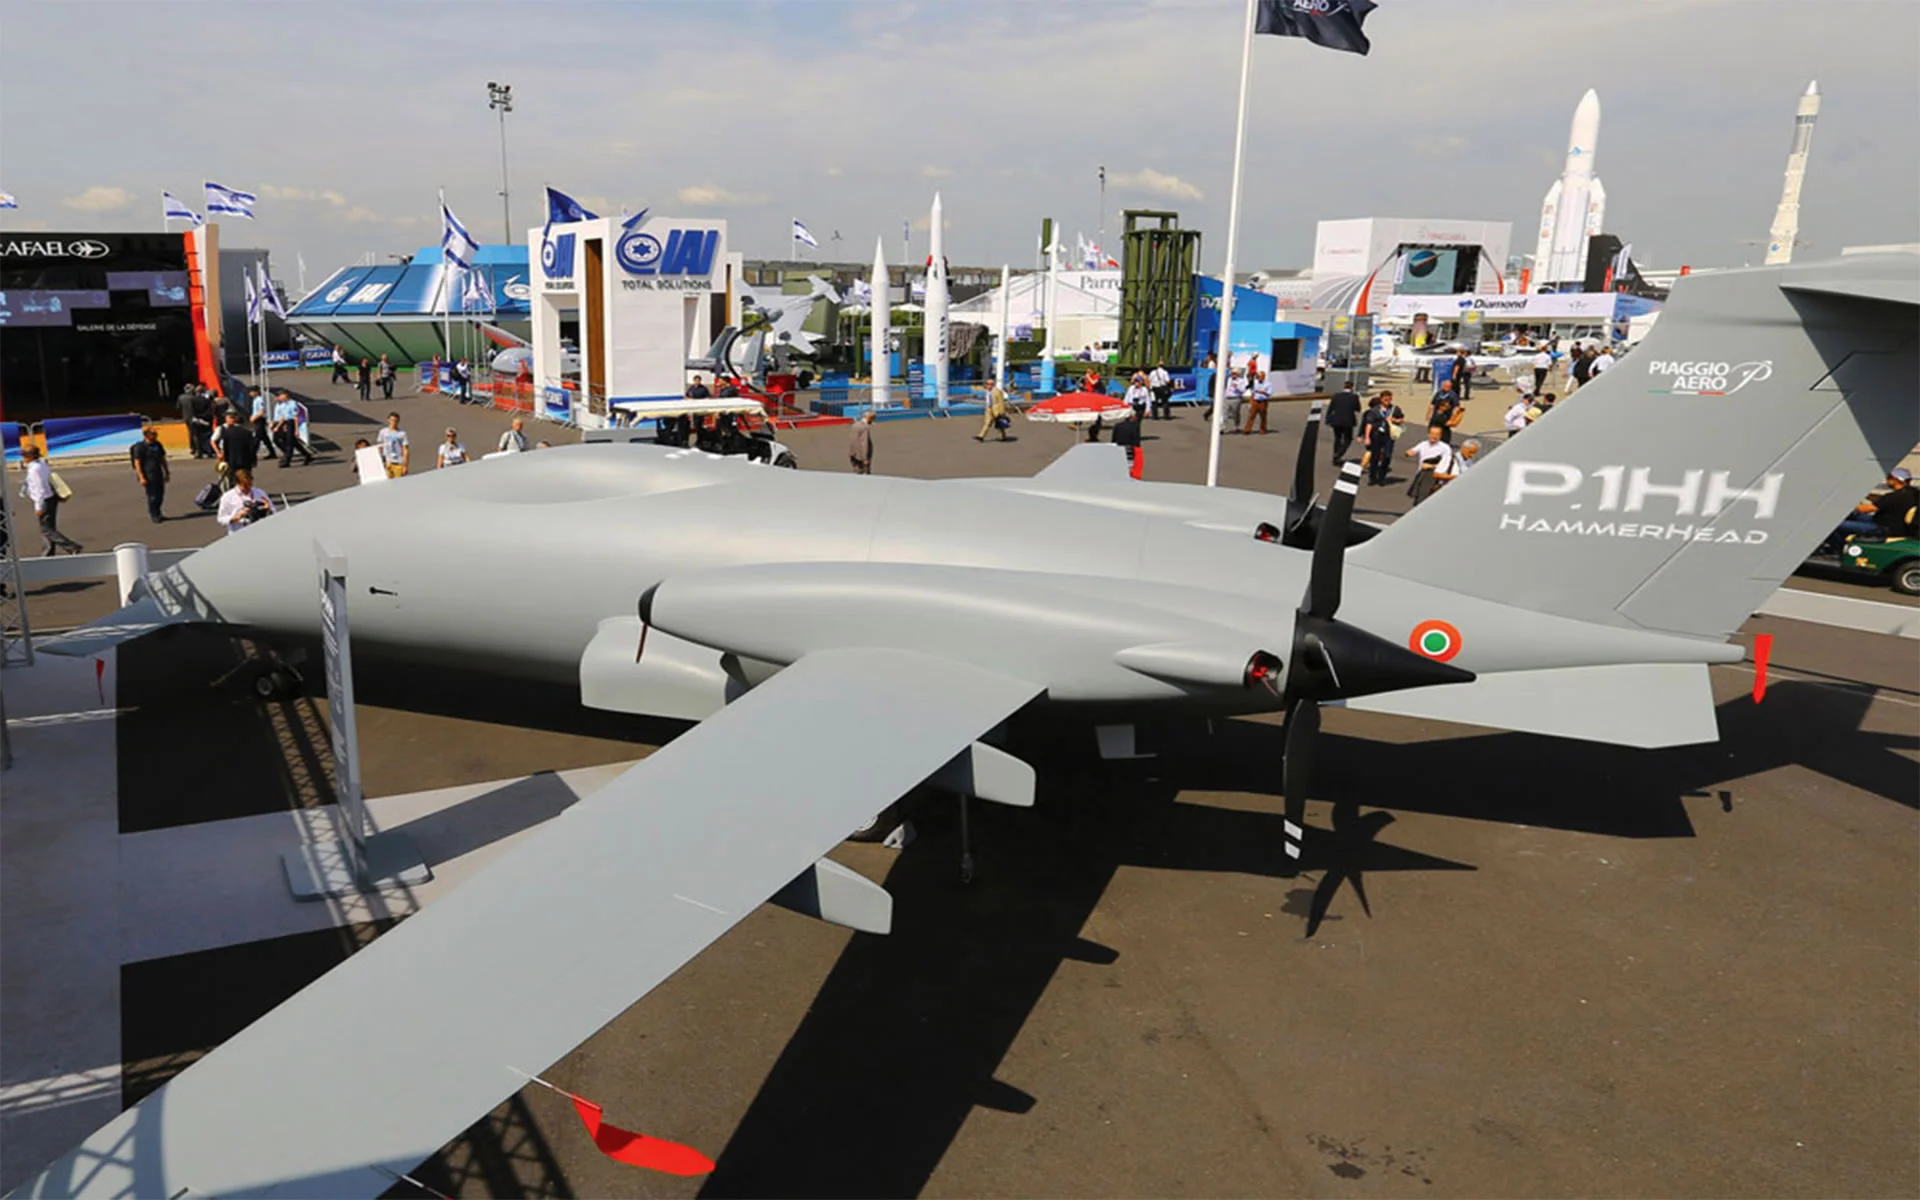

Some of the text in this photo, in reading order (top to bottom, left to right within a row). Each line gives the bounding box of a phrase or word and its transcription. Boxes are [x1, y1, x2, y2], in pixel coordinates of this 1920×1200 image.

[659, 229, 719, 275] IAI
[621, 279, 713, 290] TOTAL SOLUTIONS
[347, 283, 393, 304] IAI
[1474, 299, 1528, 310] Diamond
[106, 324, 116, 332] DE
[116, 324, 126, 332] LA
[1649, 361, 1730, 377] PIAGGIO
[1672, 375, 1728, 390] AERO
[1503, 461, 1785, 520] P.1HH
